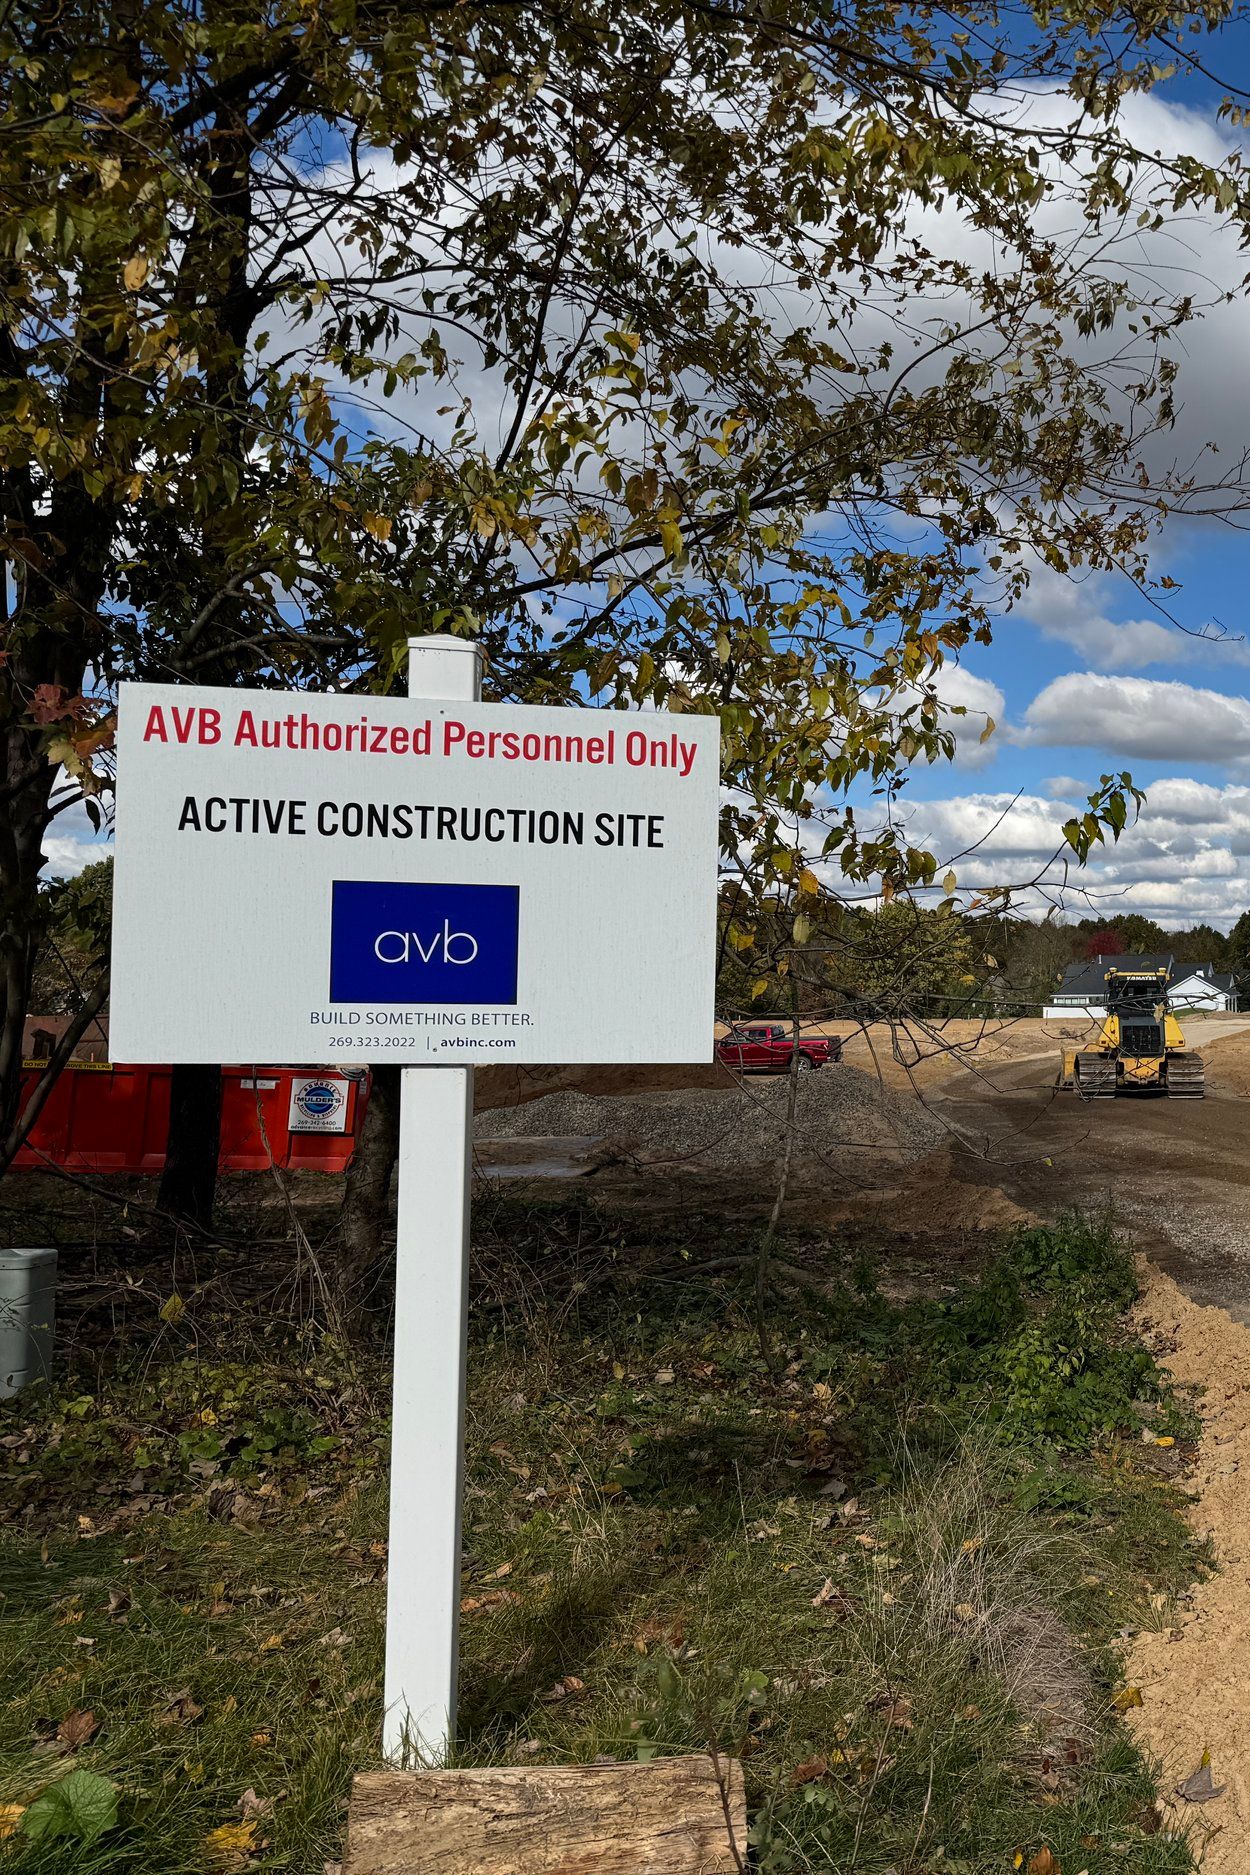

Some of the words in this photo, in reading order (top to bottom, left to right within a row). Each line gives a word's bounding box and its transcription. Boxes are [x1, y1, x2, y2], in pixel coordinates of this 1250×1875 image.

[144, 705, 221, 745] AVB
[234, 710, 432, 755] Authorized
[443, 721, 615, 765] Personnel
[626, 731, 698, 777] Only
[178, 796, 306, 835] ACTIVE
[317, 802, 584, 845] CONSTRUCTION
[594, 813, 665, 848] SITE
[374, 918, 478, 965] avb
[310, 1011, 360, 1025] BUILD
[365, 1011, 466, 1026] SOMETHING
[471, 1012, 535, 1026] BETTER.
[328, 1036, 416, 1048] 269.323.2022
[440, 1036, 516, 1048] avbinc.com
